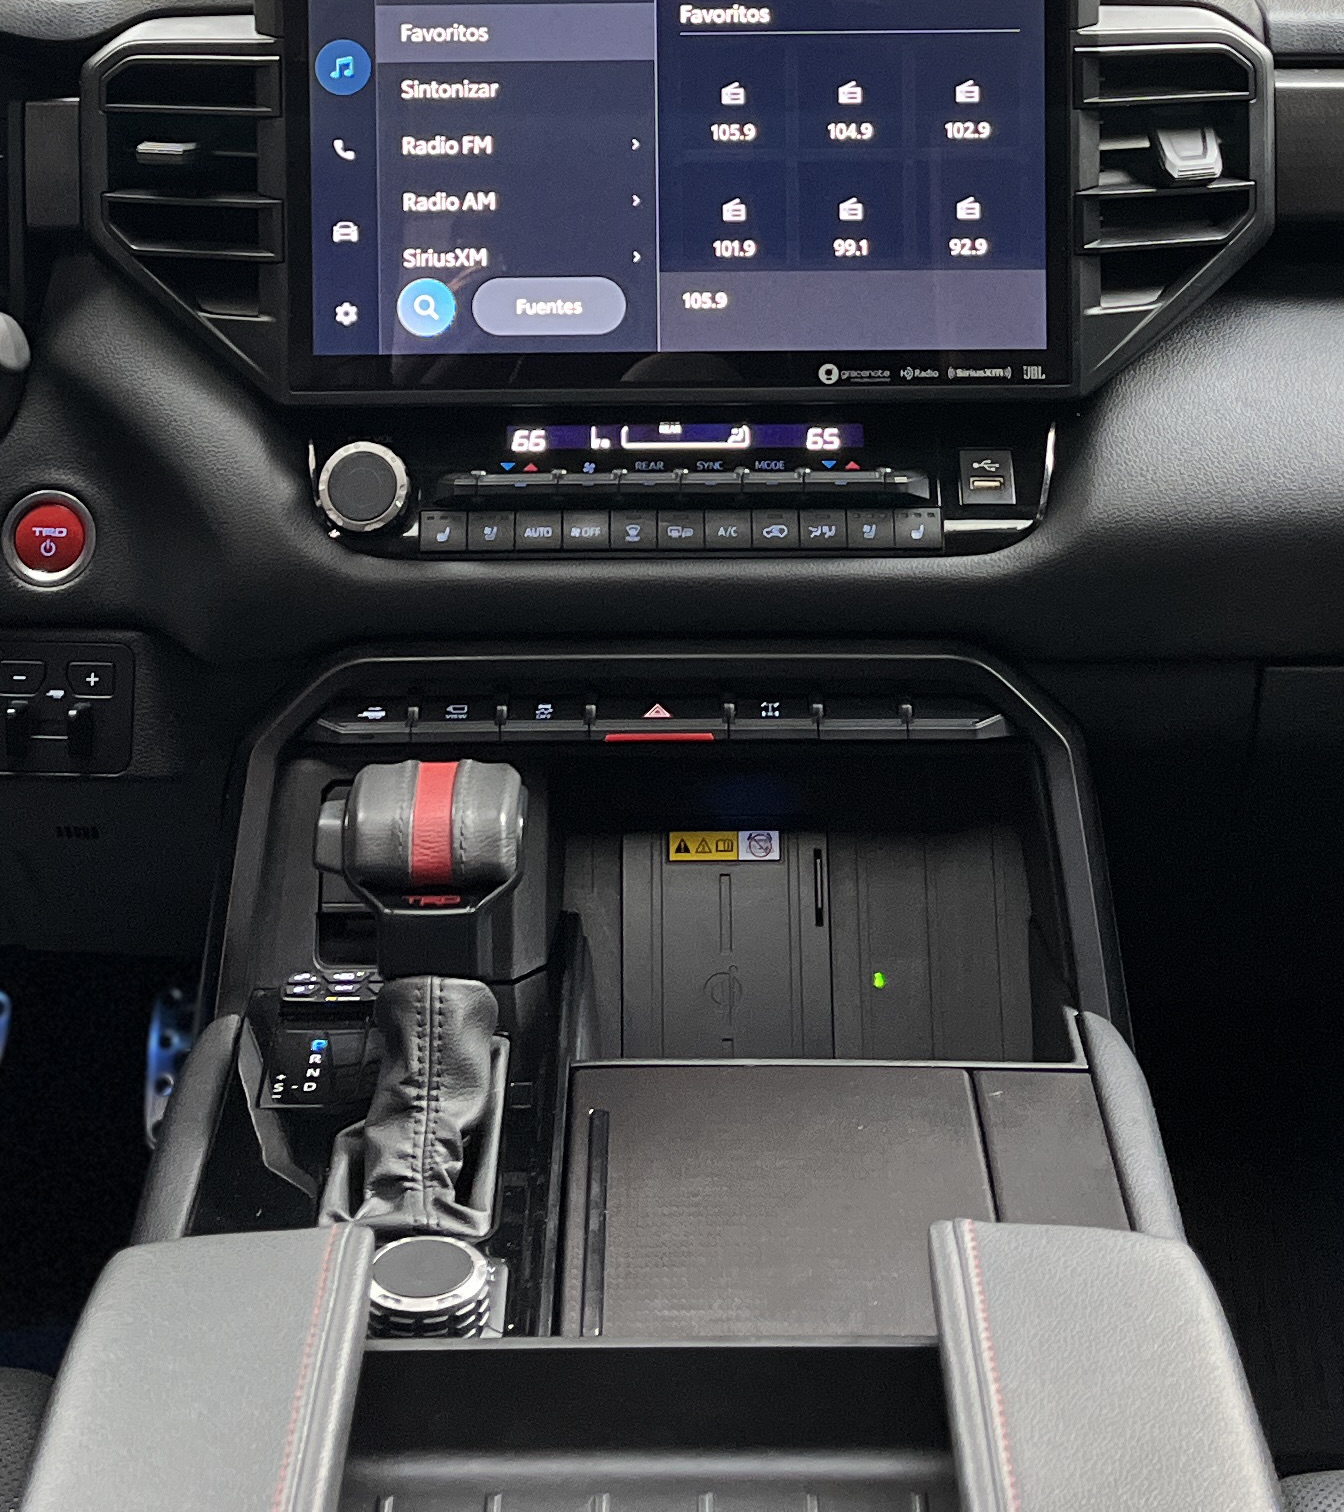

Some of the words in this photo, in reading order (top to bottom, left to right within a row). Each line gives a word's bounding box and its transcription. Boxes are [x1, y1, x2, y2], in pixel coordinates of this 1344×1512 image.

[680, 4, 770, 24] Favoritos
[401, 24, 488, 42] Favoritos
[401, 80, 499, 99] Sintonizar
[711, 123, 756, 141] 105.9
[828, 123, 873, 140] 104.9
[945, 122, 991, 139] 102.9
[402, 136, 457, 155] Radio
[460, 136, 492, 154] FM
[403, 192, 458, 211] Radio
[461, 192, 496, 210] AM
[713, 240, 756, 257] 101.9
[833, 239, 868, 256] 99.1
[949, 239, 988, 256] 92.9
[403, 248, 487, 271] SiriusXM
[515, 299, 583, 317] Fuentes
[683, 292, 728, 309] 105.9
[840, 370, 891, 380] gracenote
[914, 369, 939, 377] Radio
[1023, 366, 1045, 379] JBL
[511, 429, 546, 452] 66
[806, 427, 841, 450] 65
[635, 461, 664, 471] REAR
[696, 461, 723, 471] SYNC
[755, 461, 785, 470] MODE
[32, 527, 67, 537] TRD
[524, 527, 552, 537] AUTO
[580, 524, 600, 537] OFF
[718, 526, 737, 537] A/C
[309, 1054, 321, 1063] R
[306, 1068, 320, 1077] N
[272, 1083, 283, 1094] S
[303, 1082, 316, 1091] D
